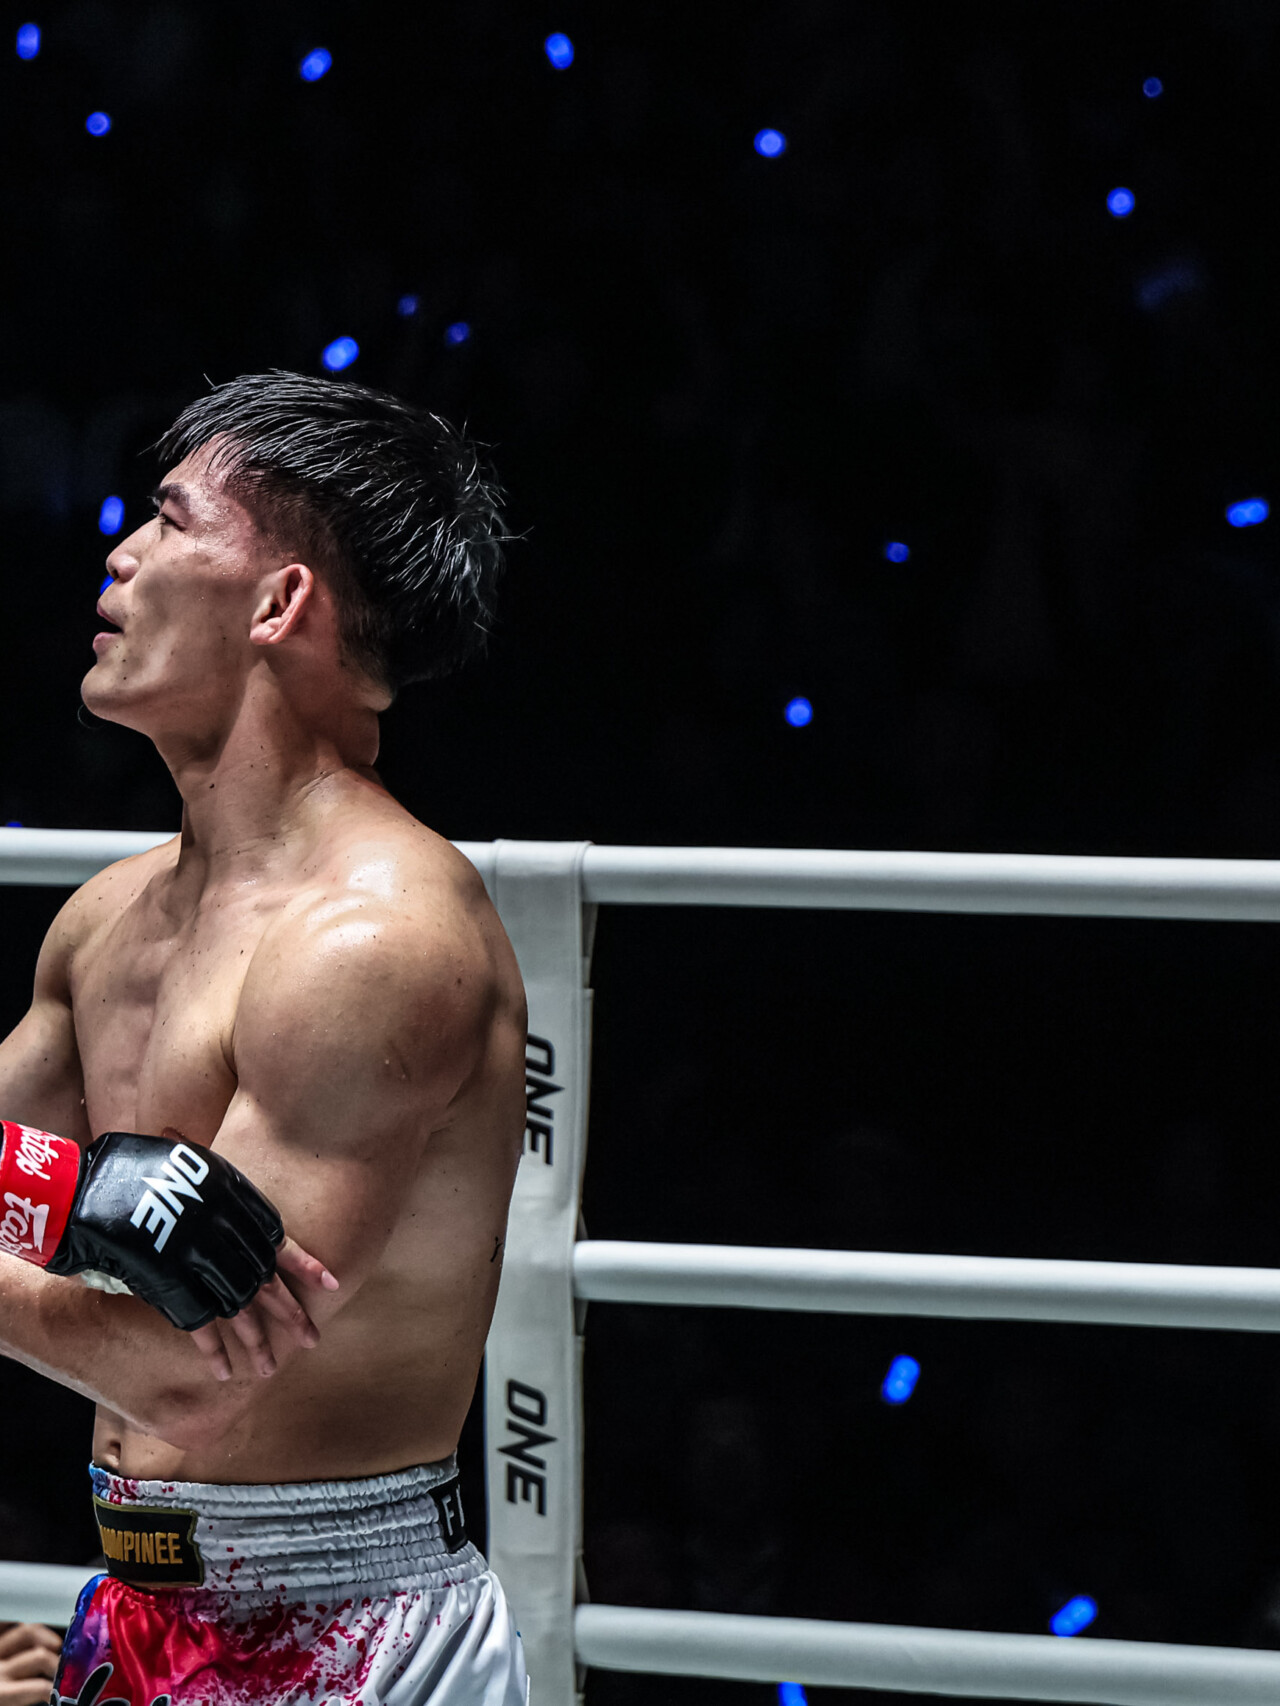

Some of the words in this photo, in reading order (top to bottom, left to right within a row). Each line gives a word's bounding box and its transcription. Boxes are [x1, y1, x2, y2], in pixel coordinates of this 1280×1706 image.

[525, 1032, 566, 1166] ONE
[129, 1143, 210, 1254] ONE
[496, 1378, 558, 1517] ONE
